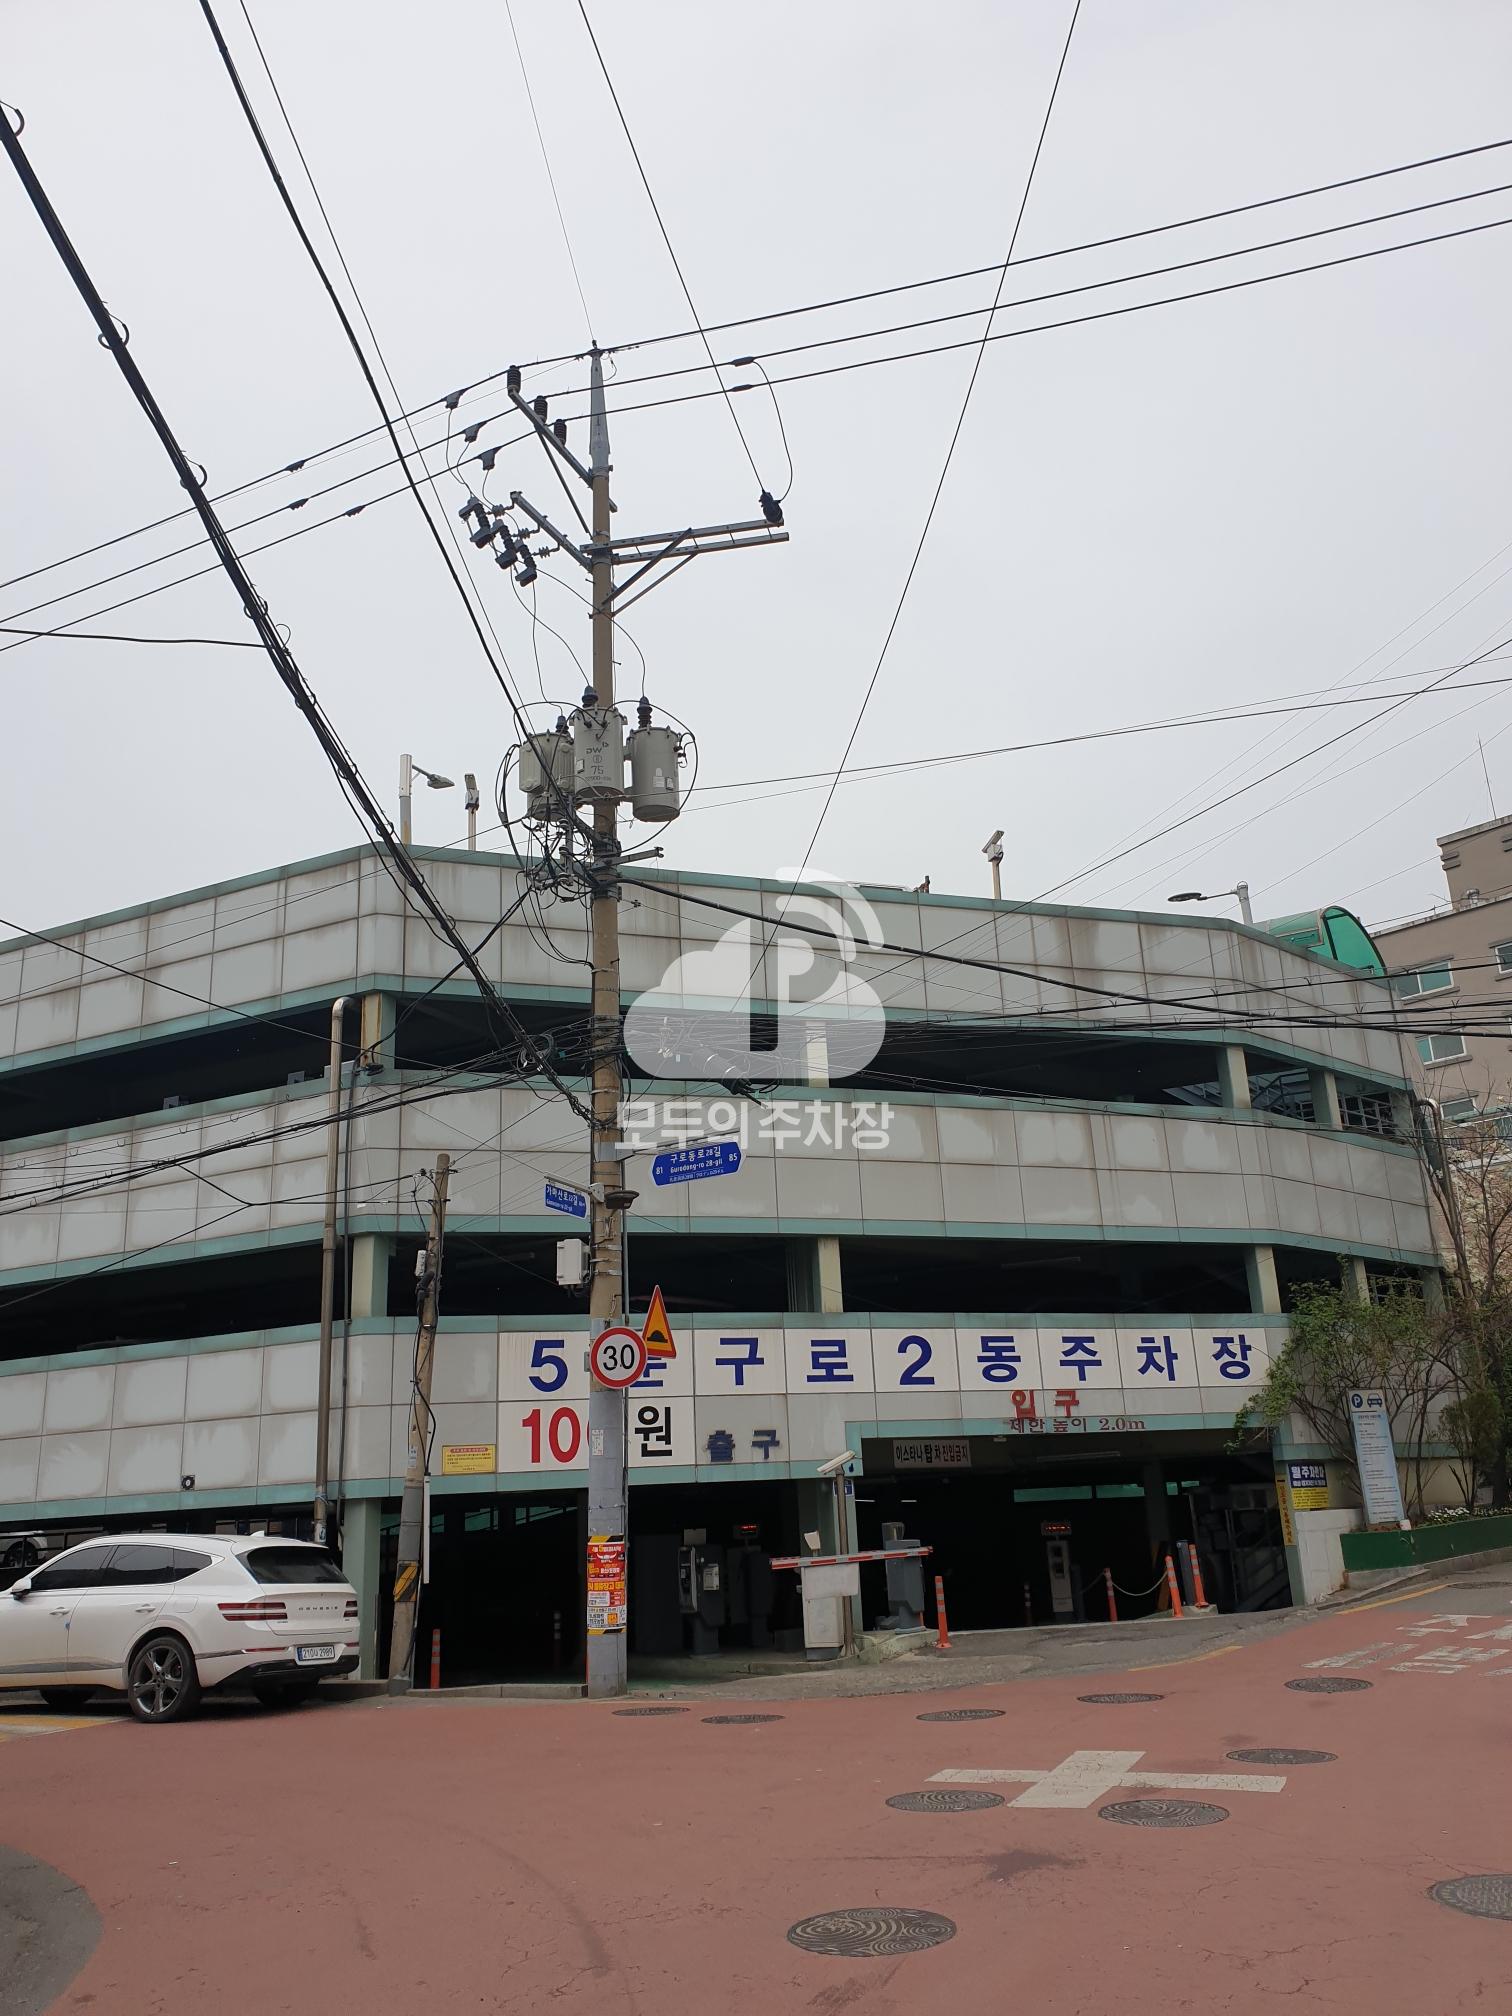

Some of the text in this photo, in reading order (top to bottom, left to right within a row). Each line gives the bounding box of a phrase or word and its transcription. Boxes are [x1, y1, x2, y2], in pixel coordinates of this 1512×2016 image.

[670, 1146, 721, 1164] 구로동로28길
[705, 1158, 723, 1168] 28-gil
[728, 1152, 738, 1162] 85
[655, 1166, 663, 1175] 81
[602, 1343, 635, 1371] 30
[1010, 1389, 1080, 1419] 입구
[1098, 1417, 1146, 1431] 2.0m
[522, 1405, 673, 1464] 10원
